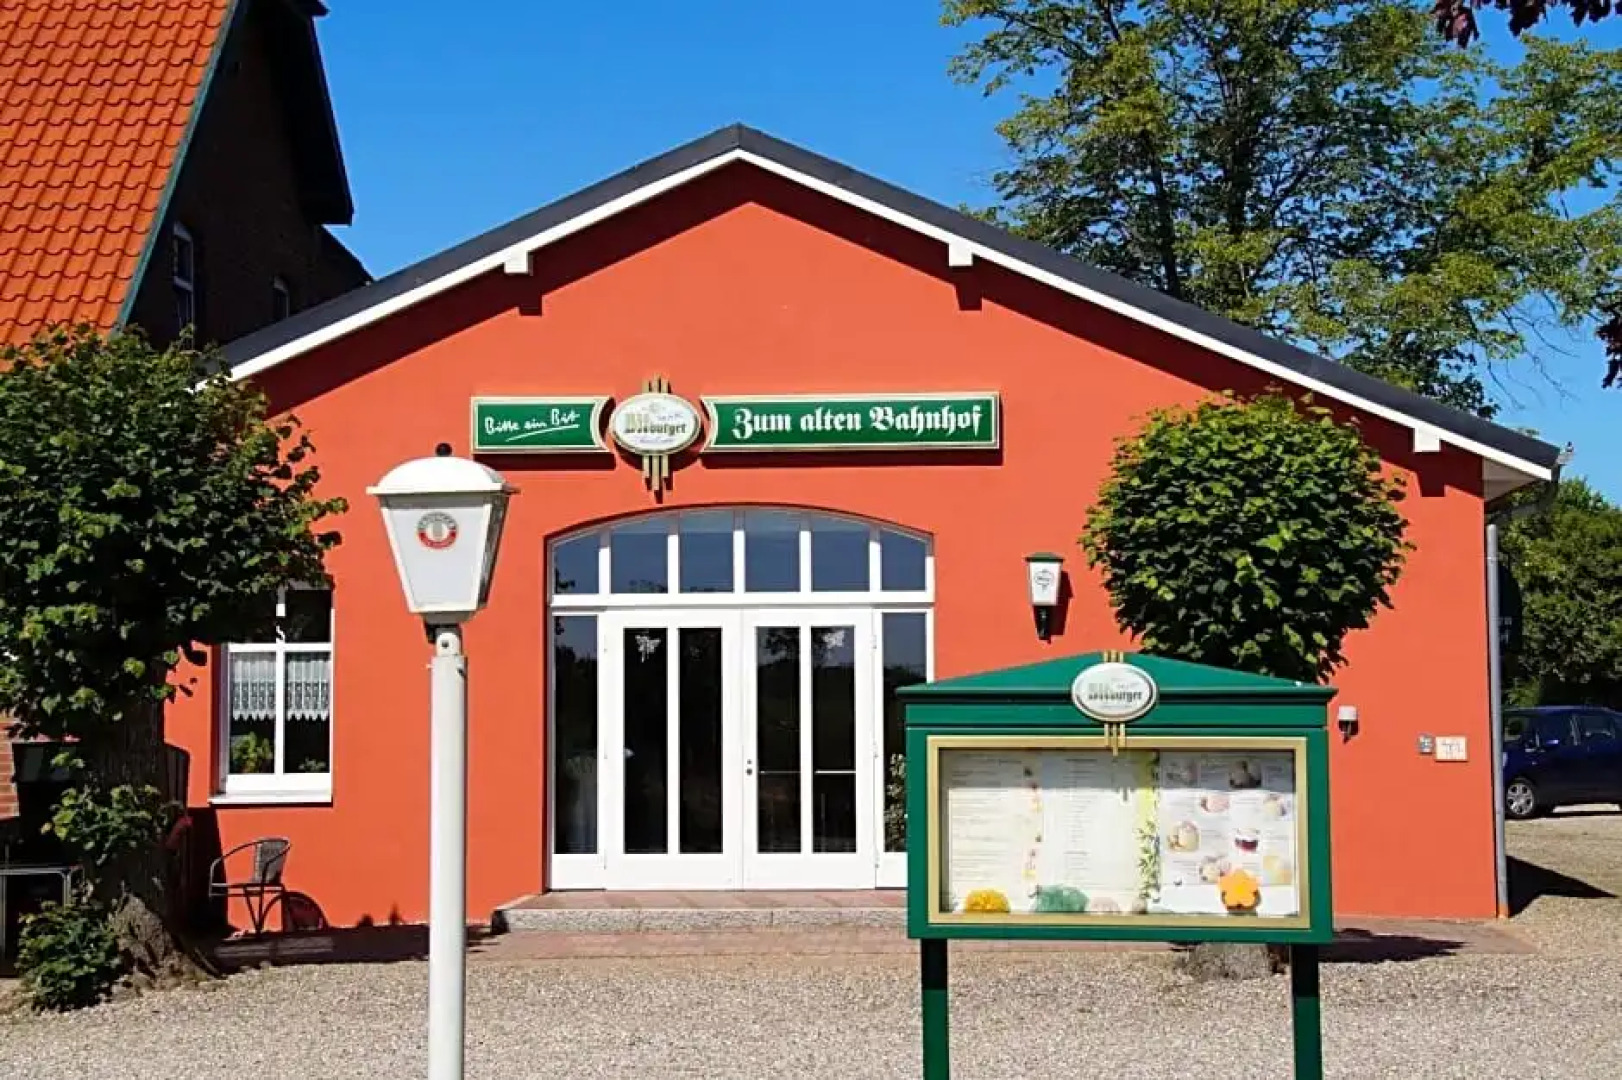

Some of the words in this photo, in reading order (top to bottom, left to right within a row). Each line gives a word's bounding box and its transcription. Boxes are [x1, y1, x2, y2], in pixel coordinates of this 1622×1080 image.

[485, 416, 520, 435] Bitte
[524, 418, 547, 430] ein
[551, 408, 580, 425] Bit
[732, 408, 791, 439] Zum
[800, 407, 862, 432] alten
[869, 404, 982, 436] Bahnhof
